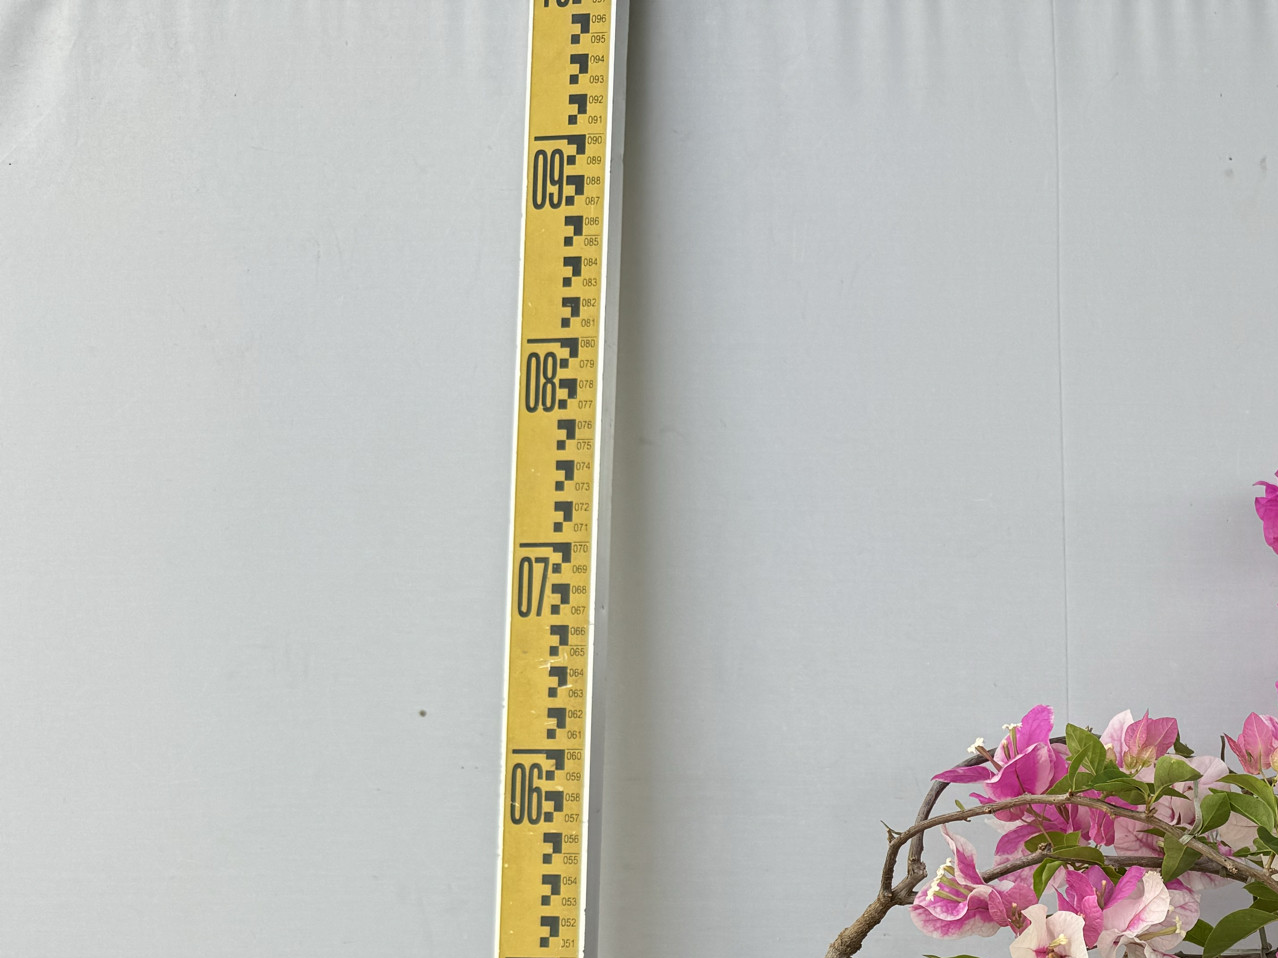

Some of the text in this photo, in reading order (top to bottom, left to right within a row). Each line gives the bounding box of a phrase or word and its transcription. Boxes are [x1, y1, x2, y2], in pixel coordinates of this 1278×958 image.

[592, 14, 606, 23] 096
[591, 35, 605, 43] 095
[590, 55, 604, 64] 094
[589, 75, 604, 84] 093
[589, 95, 603, 103] 092
[588, 116, 602, 124] 091
[587, 136, 602, 144] 090
[587, 156, 601, 165] 089
[532, 149, 564, 210] 09
[586, 177, 601, 185] 088
[585, 197, 600, 205] 087
[585, 217, 599, 225] 086
[584, 238, 599, 246] 085
[583, 258, 597, 266] 084
[583, 279, 597, 287] 083
[582, 299, 596, 307] 082
[581, 319, 595, 327] 081
[580, 339, 595, 347] 080
[580, 360, 594, 368] 079
[525, 352, 557, 413] 08
[579, 380, 593, 388] 078
[578, 400, 593, 409] 077
[577, 421, 592, 429] 076
[577, 442, 591, 450] 075
[576, 462, 590, 470] 074
[575, 483, 590, 491] 073
[574, 503, 589, 511] 072
[573, 524, 588, 532] 071
[573, 545, 588, 553] 070
[572, 565, 587, 573] 069
[518, 557, 550, 618] 07
[572, 586, 586, 594] 068
[571, 606, 586, 615] 067
[570, 627, 585, 635] 066
[570, 648, 584, 656] 065
[569, 668, 583, 677] 064
[569, 689, 583, 698] 063
[568, 710, 583, 718] 062
[567, 730, 581, 739] 061
[567, 752, 581, 760] 060
[566, 772, 581, 781] 059
[511, 763, 543, 825] 06
[565, 793, 580, 802] 058
[565, 814, 579, 822] 057
[564, 835, 579, 843] 056
[563, 856, 578, 864] 055
[562, 877, 577, 885] 054
[562, 898, 576, 906] 053
[561, 918, 576, 927] 052
